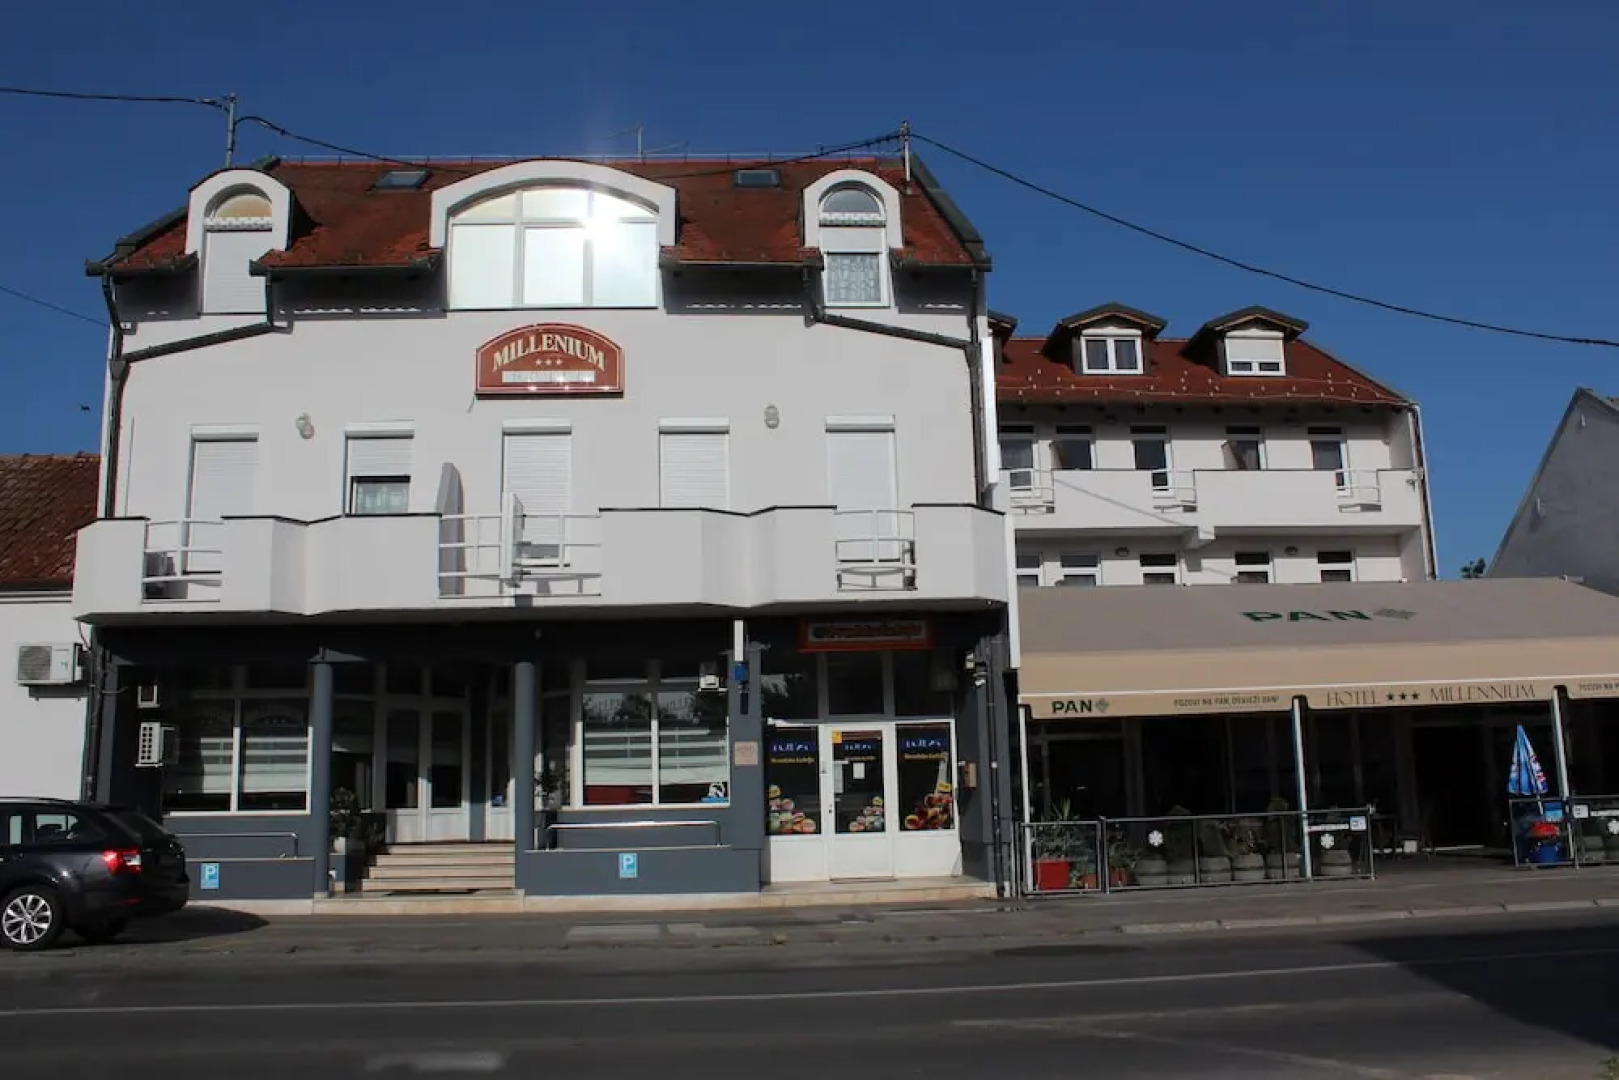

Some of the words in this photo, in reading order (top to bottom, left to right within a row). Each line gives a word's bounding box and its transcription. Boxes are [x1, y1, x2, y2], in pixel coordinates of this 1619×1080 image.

[492, 334, 605, 371] MILLENIUM
[1242, 609, 1373, 622] PAN
[1326, 689, 1380, 706] HOTEL
[1430, 683, 1536, 701] MILLENNIUM
[1051, 699, 1092, 714] PAN
